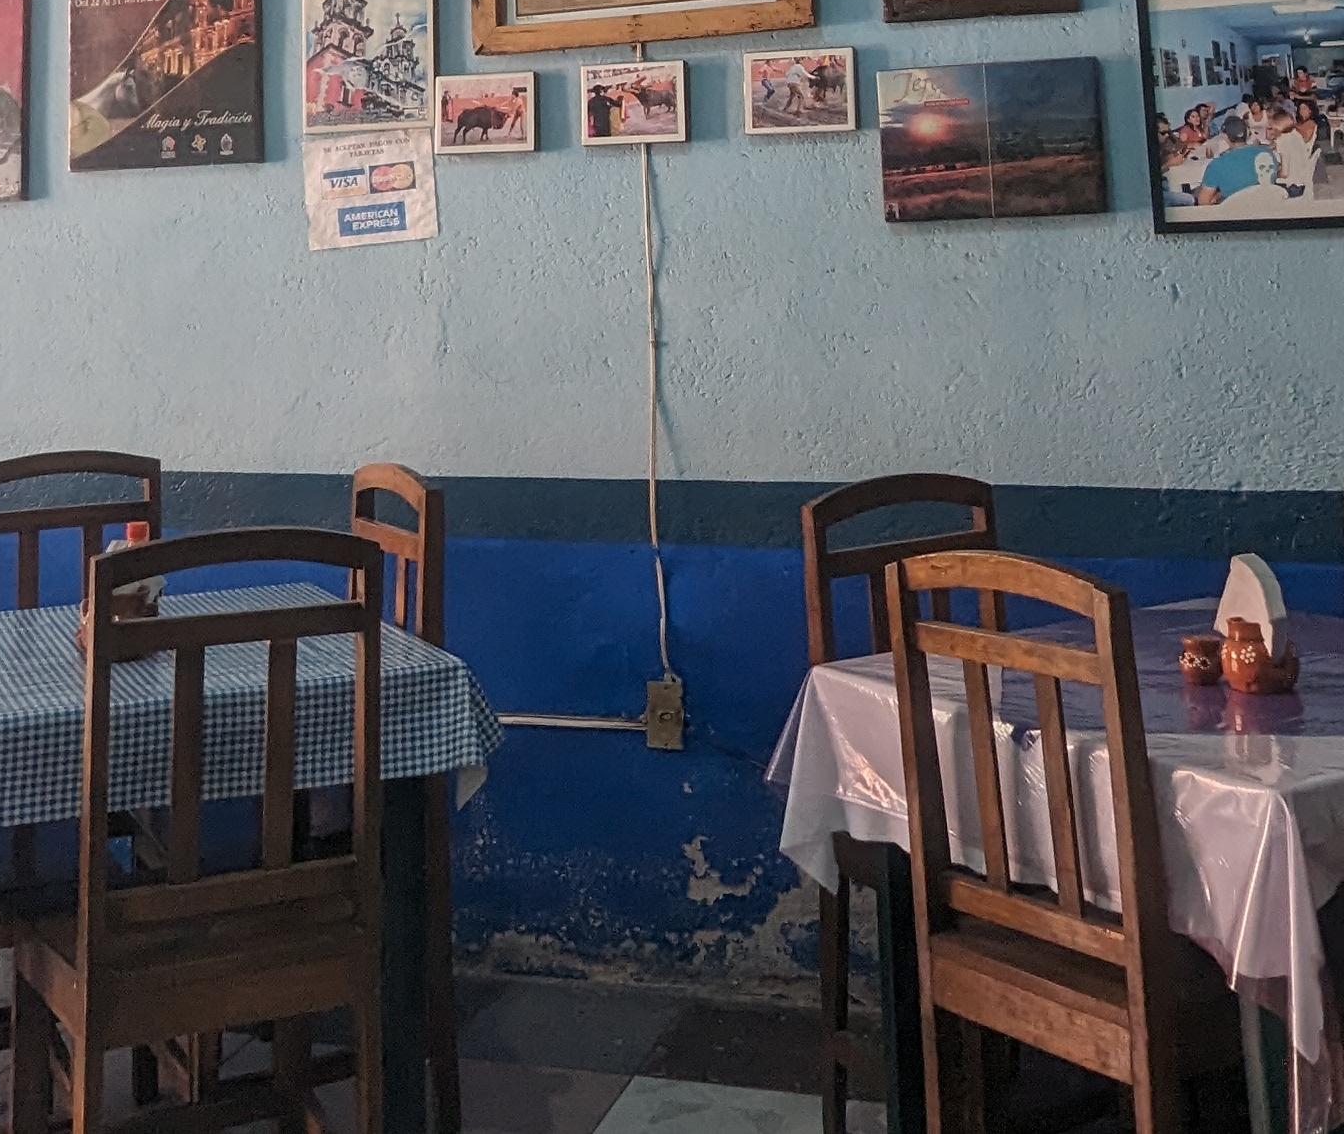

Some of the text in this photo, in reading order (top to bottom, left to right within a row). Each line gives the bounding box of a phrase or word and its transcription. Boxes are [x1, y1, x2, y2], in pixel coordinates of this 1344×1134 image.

[140, 110, 253, 133] Magia y Tradición
[369, 139, 394, 147] PAGOS
[330, 176, 359, 189] VISA
[344, 208, 399, 222] AMERICAN
[352, 217, 401, 231] EXPRESS
